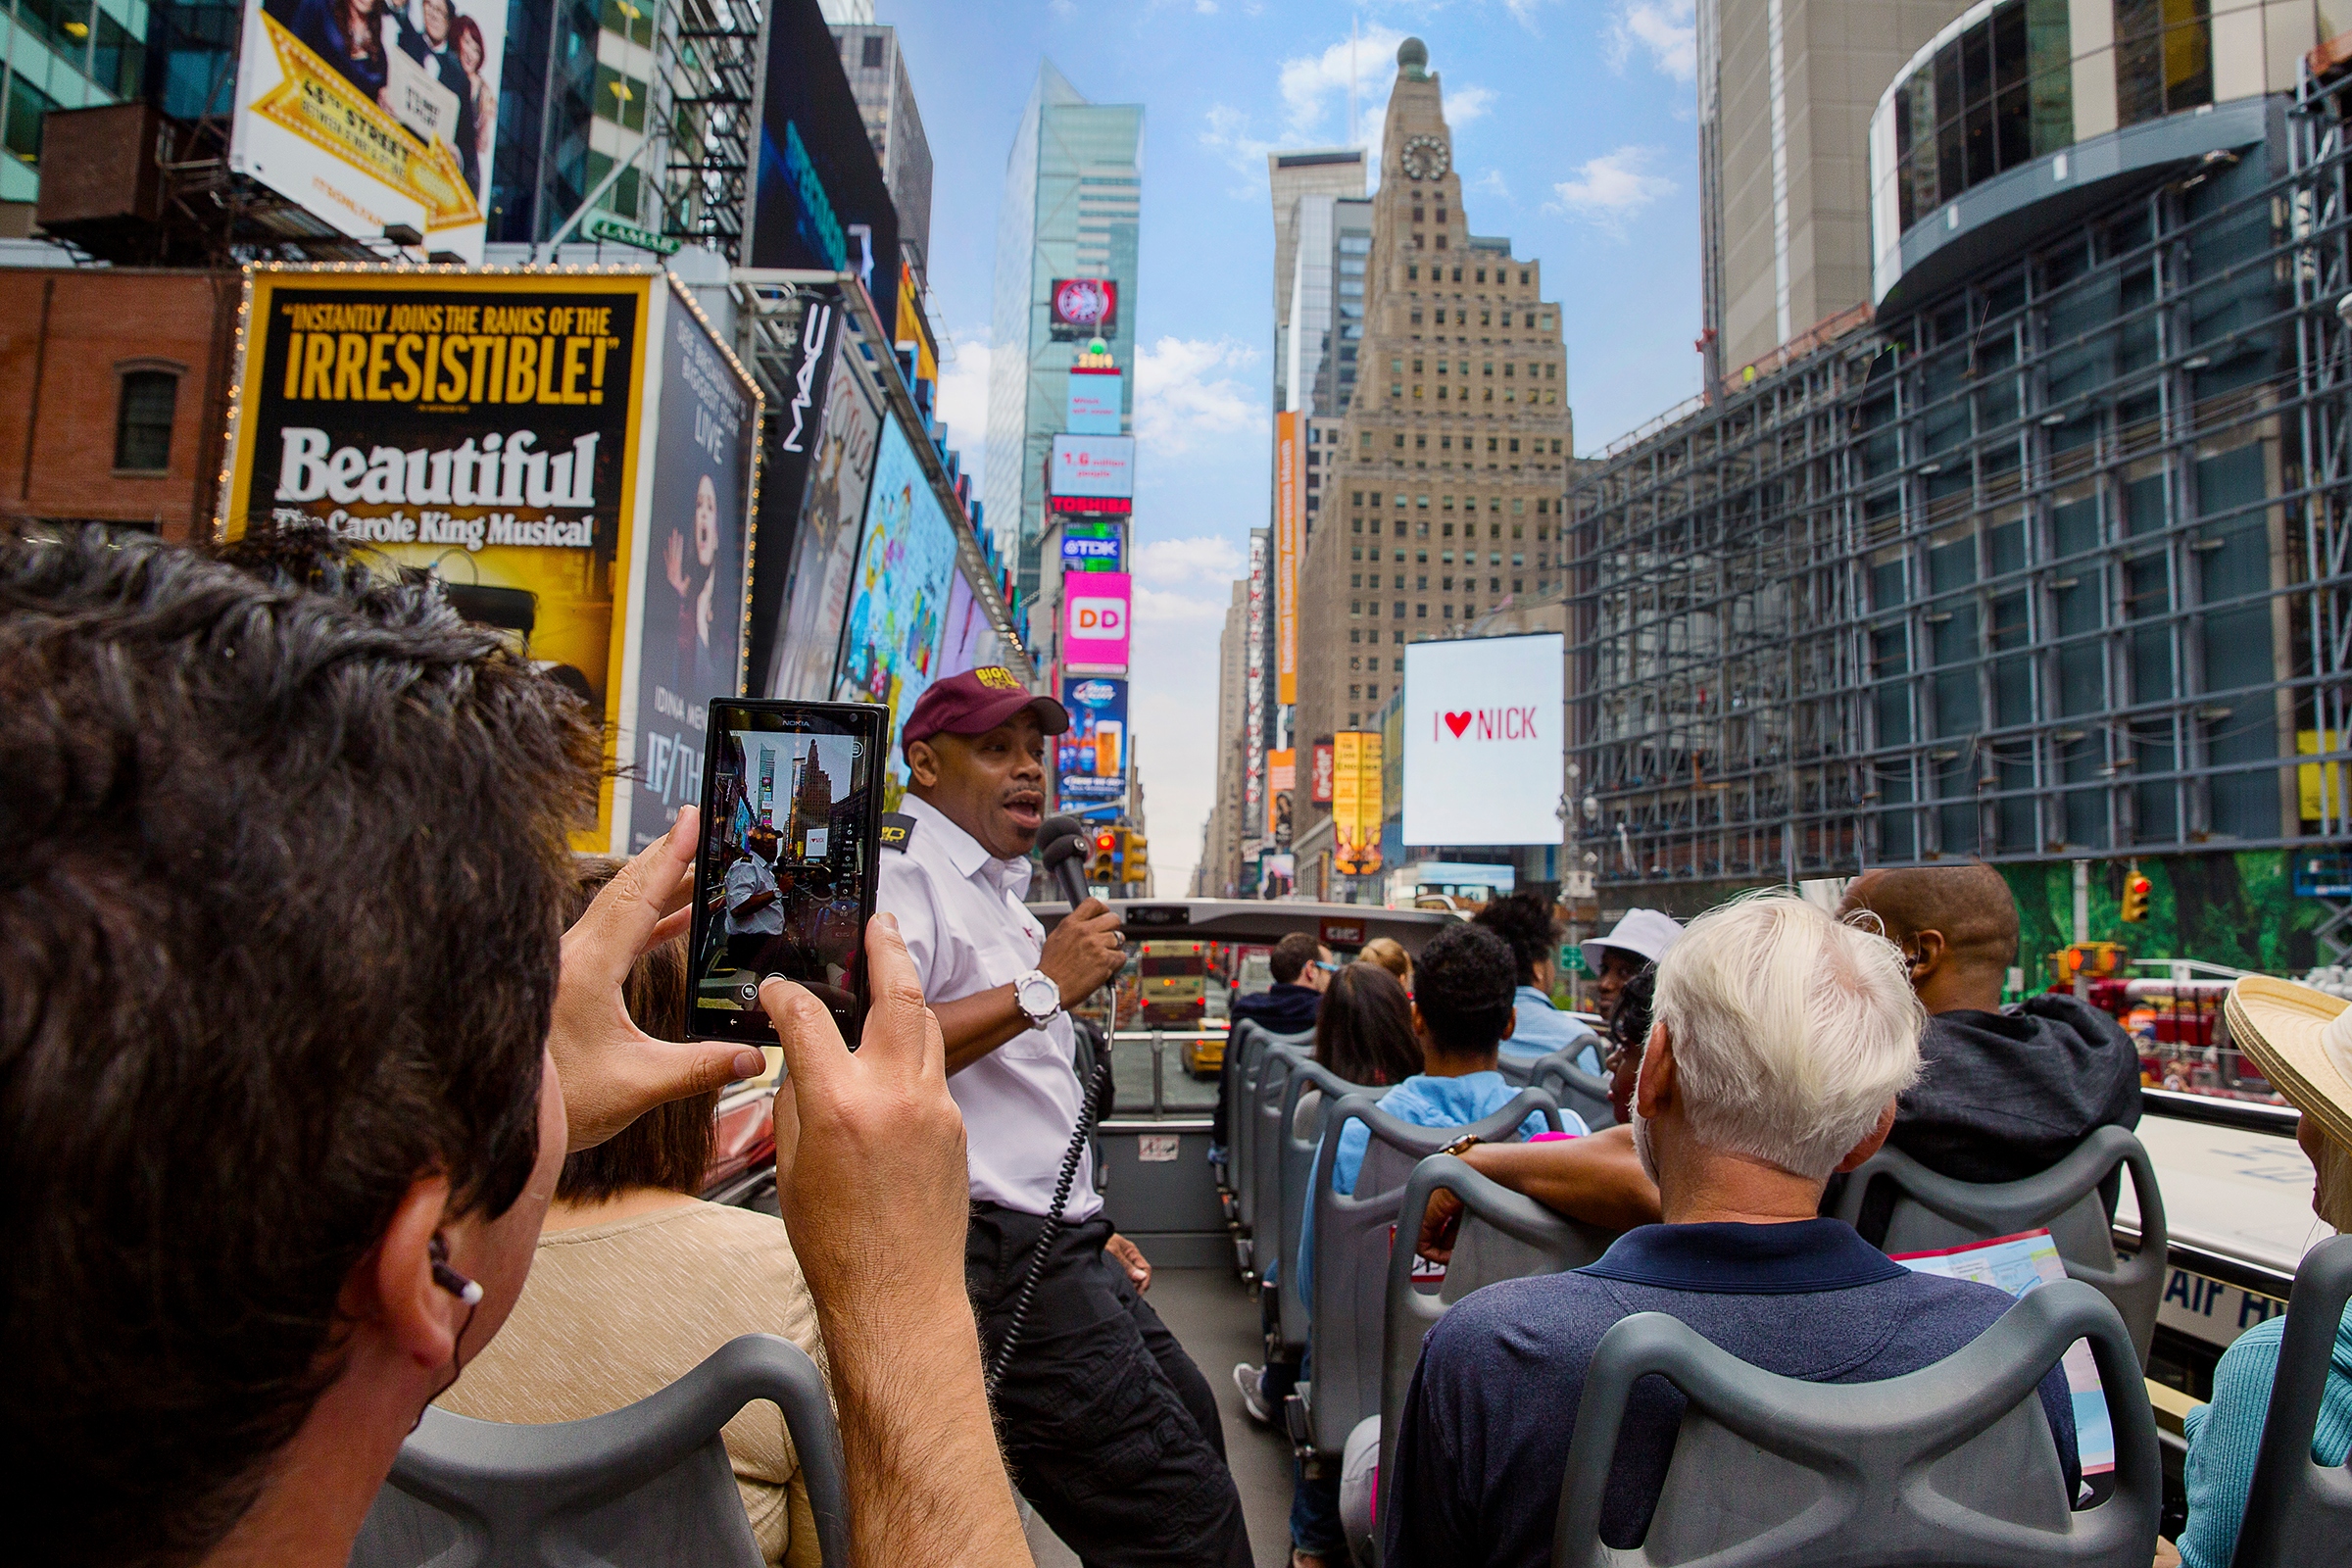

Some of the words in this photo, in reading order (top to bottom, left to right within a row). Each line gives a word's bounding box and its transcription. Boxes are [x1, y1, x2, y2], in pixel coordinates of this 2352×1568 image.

[388, 305, 442, 334] JOINS
[444, 306, 480, 333] THE
[482, 306, 546, 335] RANKS
[548, 307, 576, 335] OF
[575, 307, 612, 336] THE
[694, 403, 724, 466] LIVE
[275, 426, 601, 509] Beautiful
[1280, 439, 1293, 482] Month
[1052, 497, 1132, 514] TOSHIBA
[326, 511, 417, 544] Carole
[418, 512, 486, 552] King
[489, 514, 595, 547] Musical
[1078, 540, 1117, 556] TDK
[1477, 705, 1538, 741] NICK
